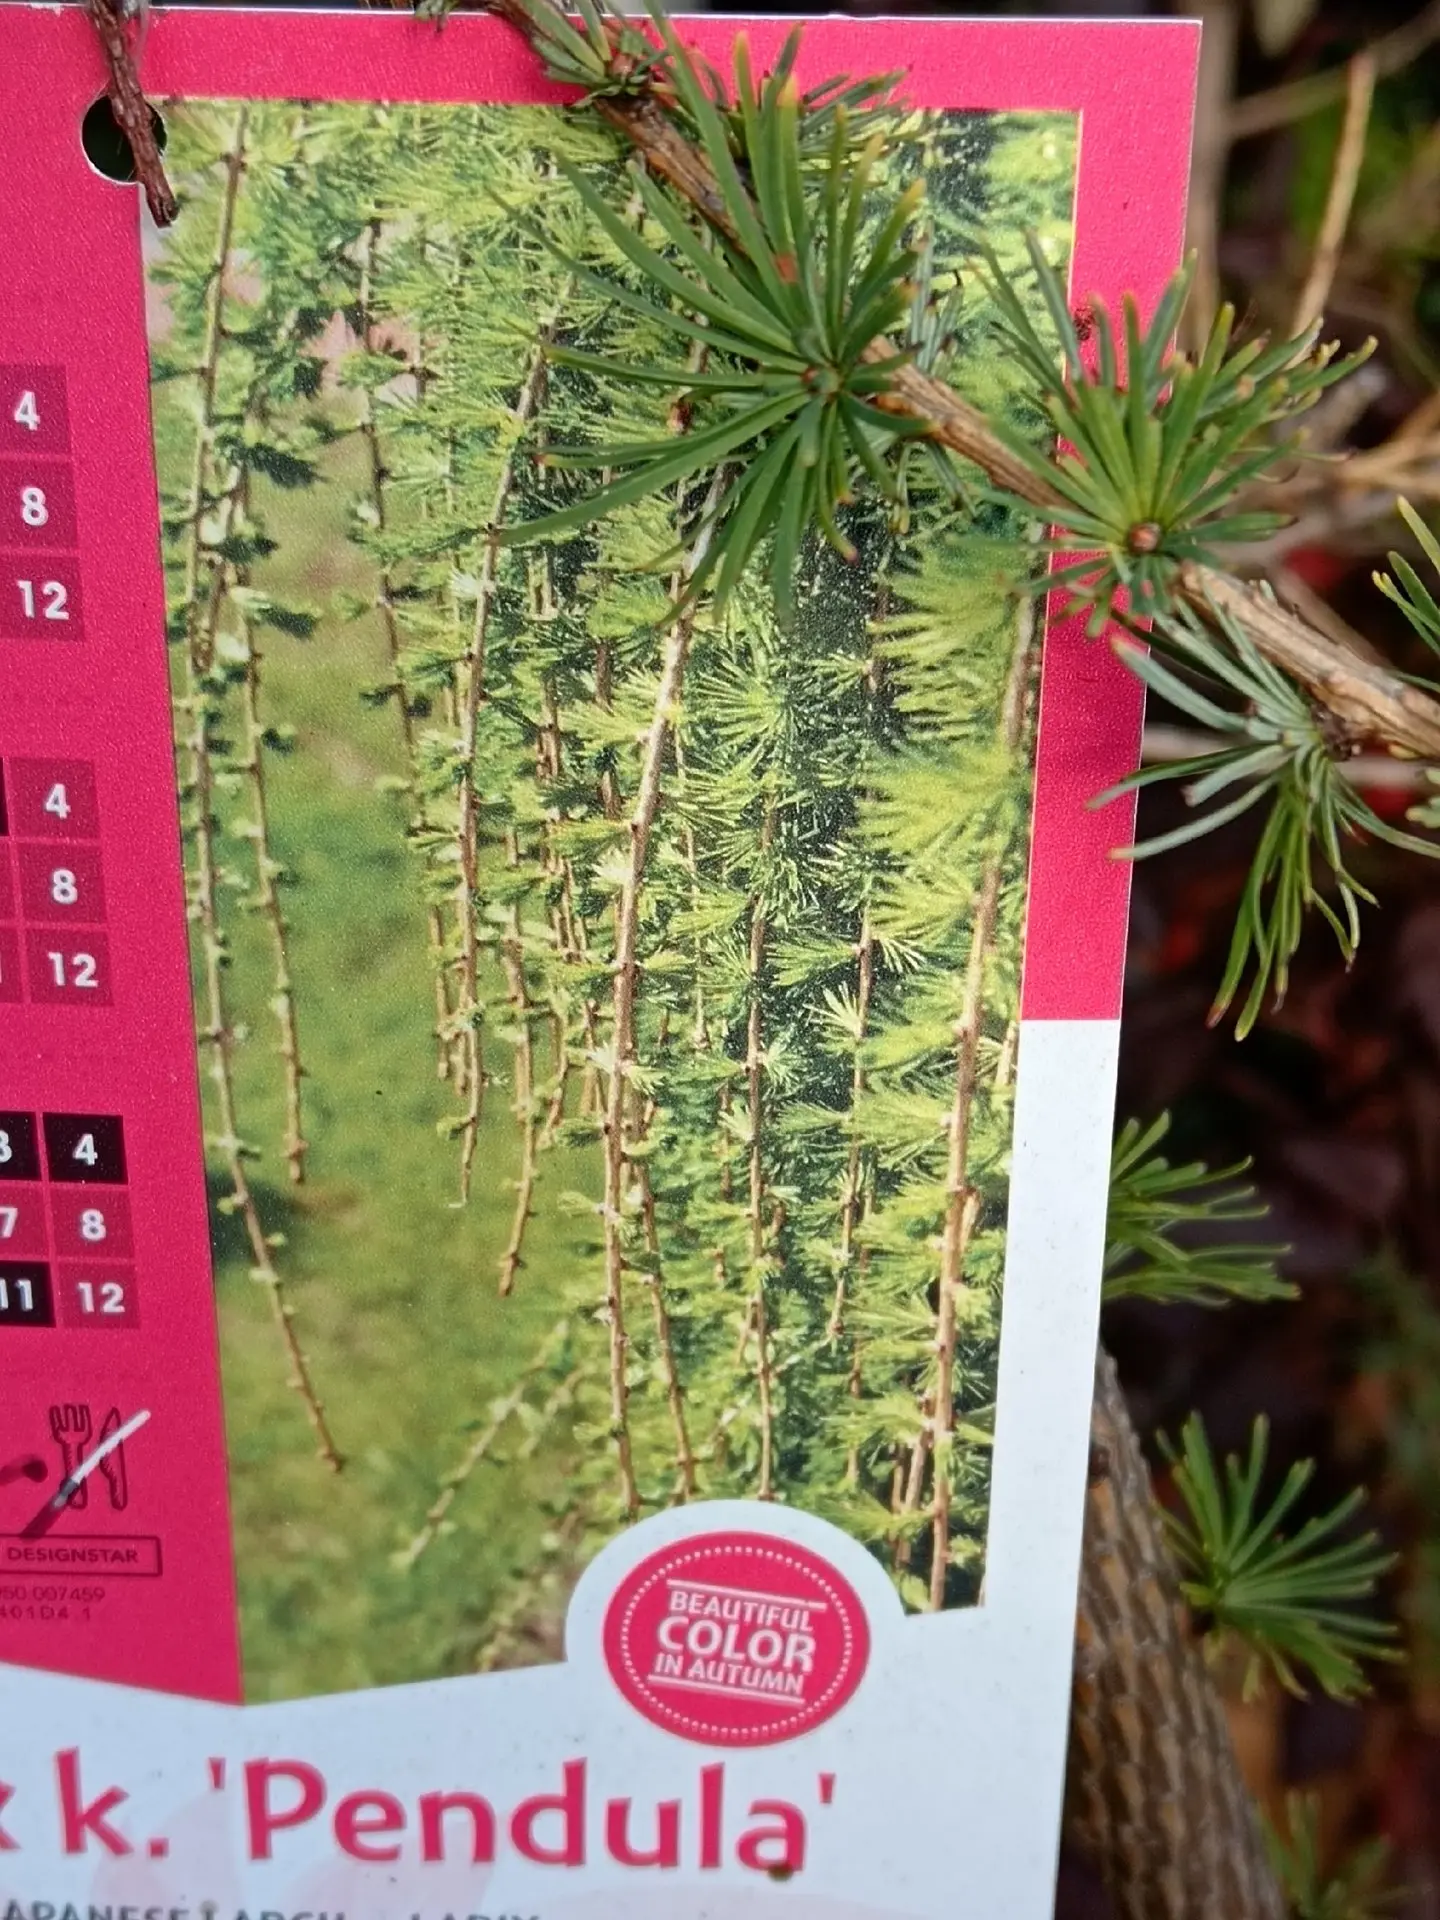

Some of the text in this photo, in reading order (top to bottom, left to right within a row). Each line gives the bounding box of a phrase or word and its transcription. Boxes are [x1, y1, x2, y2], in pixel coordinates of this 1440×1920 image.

[14, 390, 40, 431] 4
[21, 487, 48, 526] 8
[18, 579, 69, 620] 12
[44, 783, 71, 819] 4
[52, 868, 78, 904] 8
[48, 952, 99, 988] 12
[72, 1133, 98, 1166] 4
[0, 1207, 107, 1241] 7 8
[77, 1281, 126, 1313] 12
[7, 1546, 139, 1563] DESIGNSTAR
[669, 1590, 813, 1632] BEAUTIFUL
[656, 1615, 816, 1672] COLOR
[654, 1651, 804, 1695] IN AUTUMN
[54, 1745, 169, 1859] k.
[207, 1757, 837, 1871] 'Pendula'
